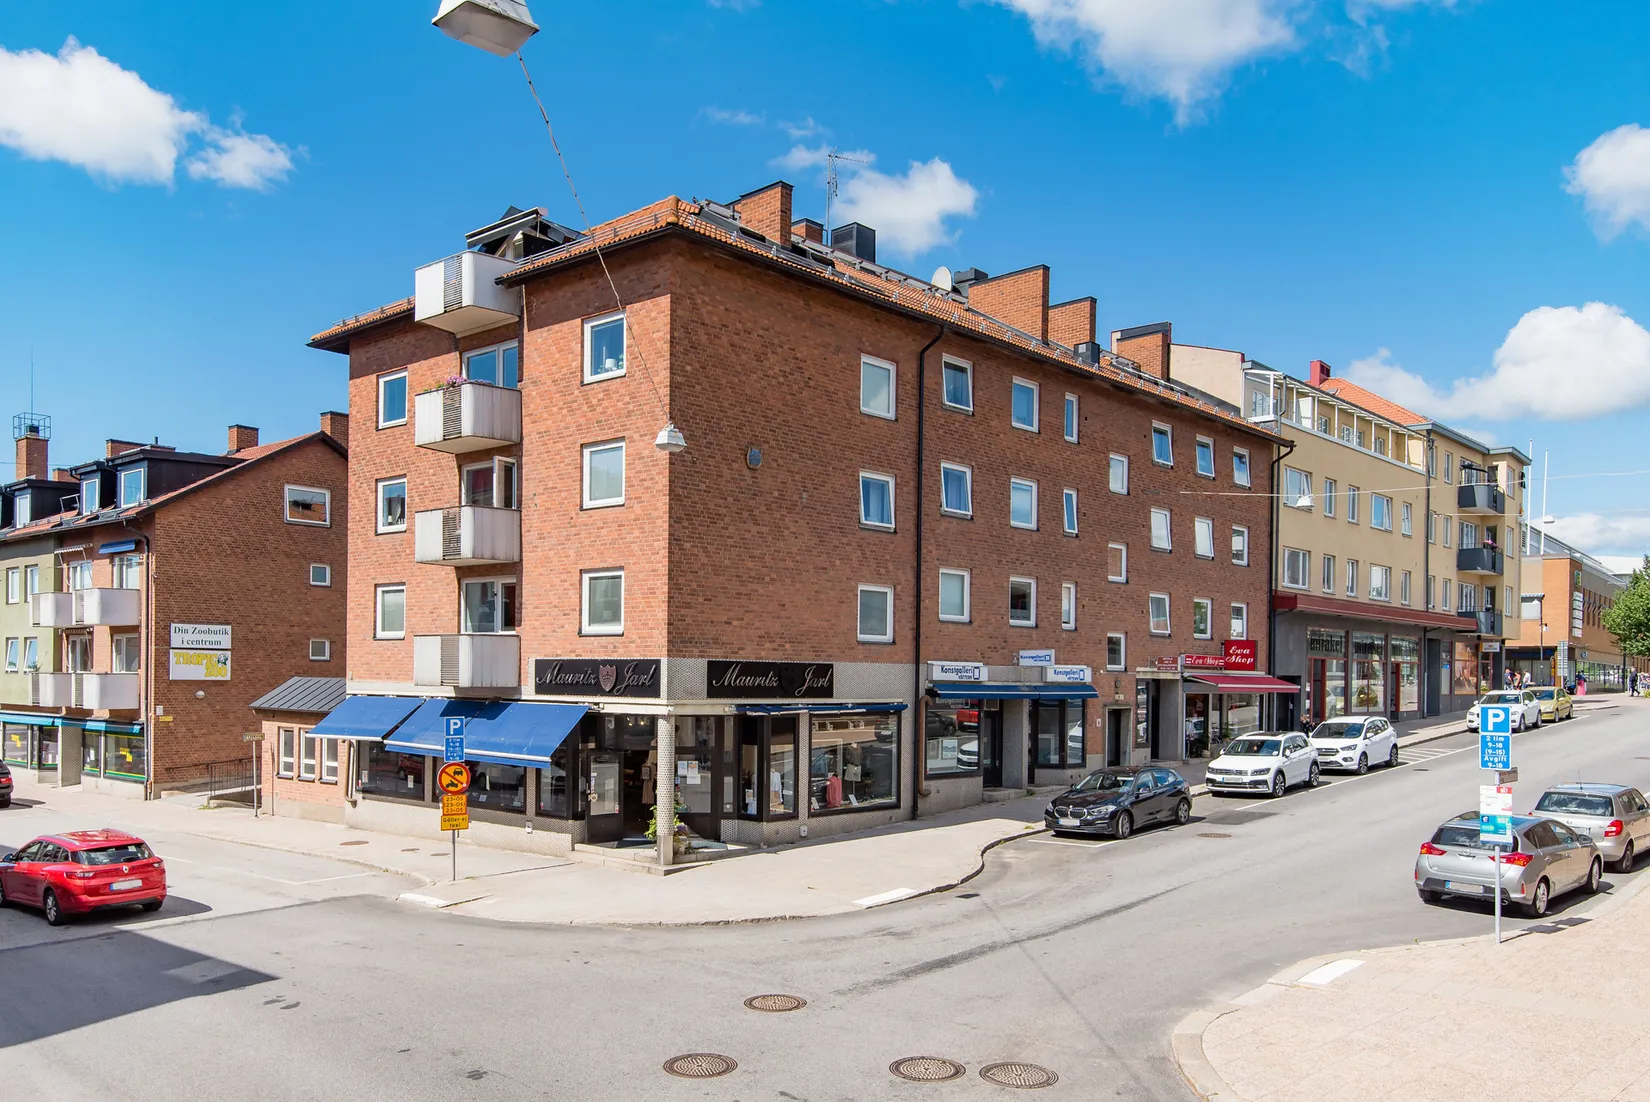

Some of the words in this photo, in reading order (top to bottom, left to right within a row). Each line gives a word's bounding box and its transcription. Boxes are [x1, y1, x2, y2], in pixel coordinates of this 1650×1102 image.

[174, 626, 189, 634] Din
[191, 627, 230, 636] Zoobutik
[186, 638, 222, 646] centrum
[1310, 635, 1343, 653] mirakel
[1229, 645, 1251, 655] Eva
[1191, 656, 1203, 664] Eva
[1225, 655, 1254, 665] Shop
[204, 663, 228, 678] ZOO
[940, 665, 973, 676] Konstgalleri
[536, 661, 597, 685] Mauritz
[614, 661, 656, 695] Jarl
[712, 663, 779, 687] Mauritz
[795, 665, 832, 696] Jarl
[1487, 708, 1506, 731] P
[450, 719, 461, 735] P
